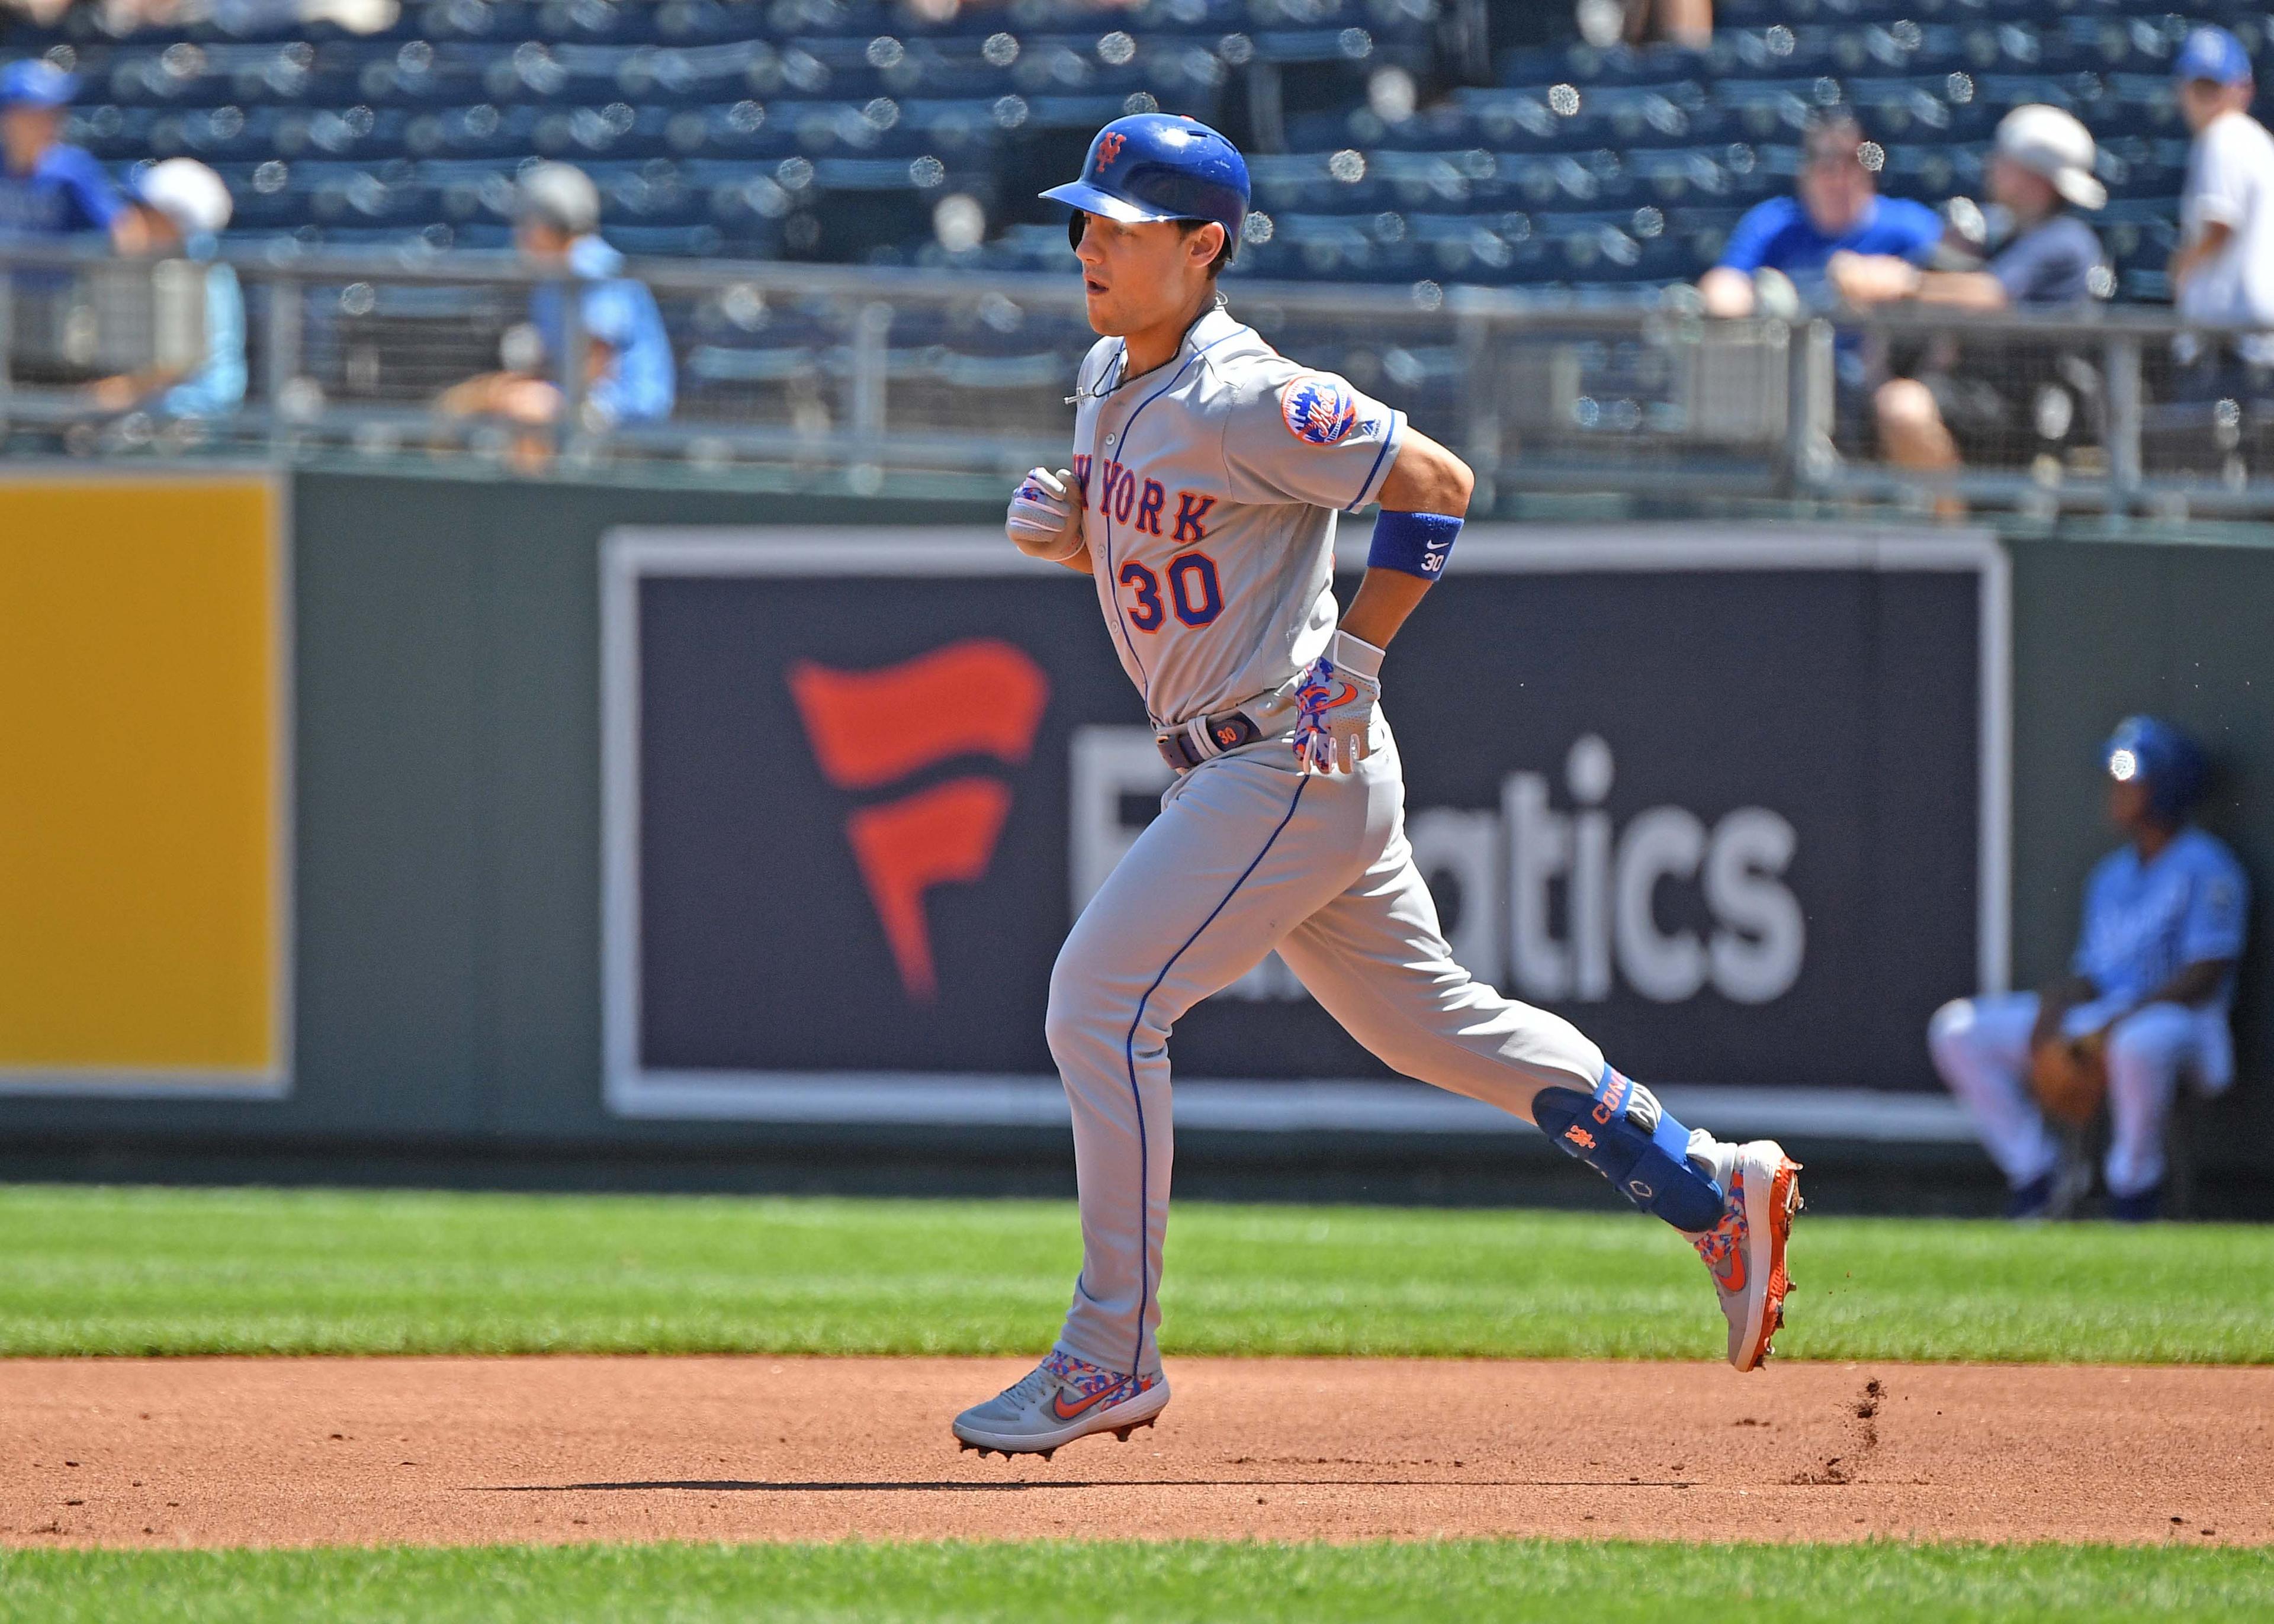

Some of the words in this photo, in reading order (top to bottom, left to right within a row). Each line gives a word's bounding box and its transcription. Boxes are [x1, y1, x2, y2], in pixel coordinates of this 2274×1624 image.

[1099, 458, 1218, 544] YORK
[1117, 549, 1225, 635] 30
[1421, 552, 1444, 572] 30
[1217, 726, 1237, 744] 30
[1068, 726, 1806, 1004] Fatics
